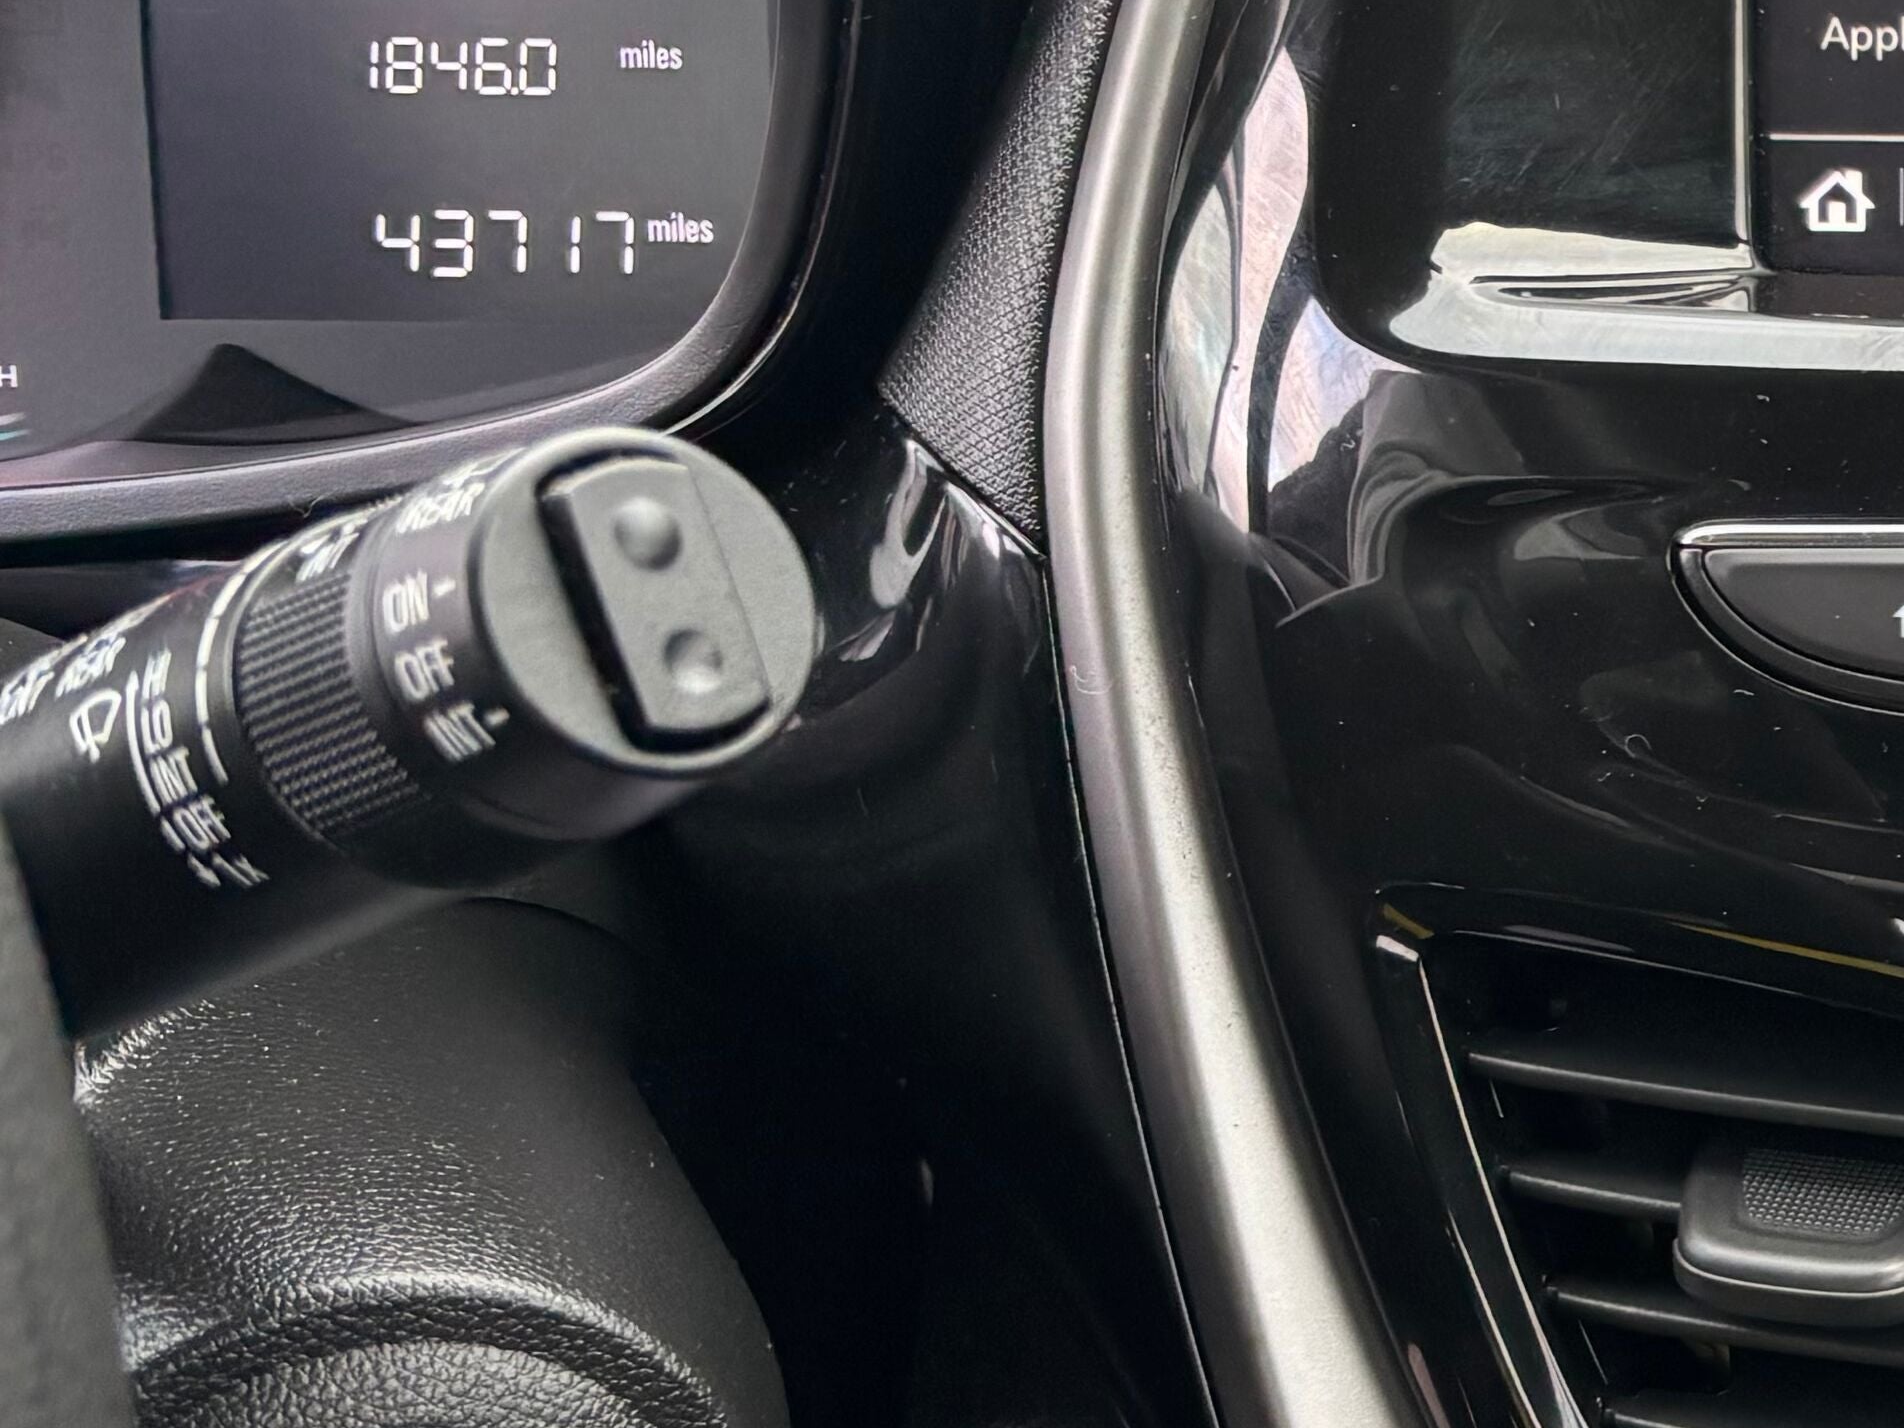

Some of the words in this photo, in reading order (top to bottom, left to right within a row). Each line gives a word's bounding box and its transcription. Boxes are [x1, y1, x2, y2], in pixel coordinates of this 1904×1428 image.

[619, 39, 683, 70] miles
[375, 209, 635, 278] 43717
[647, 211, 714, 244] miles
[383, 570, 430, 635] ON
[395, 638, 455, 701] OFF
[142, 698, 174, 755] LO
[424, 702, 497, 762] INT
[151, 746, 199, 806] INT
[174, 795, 232, 853] OFF
